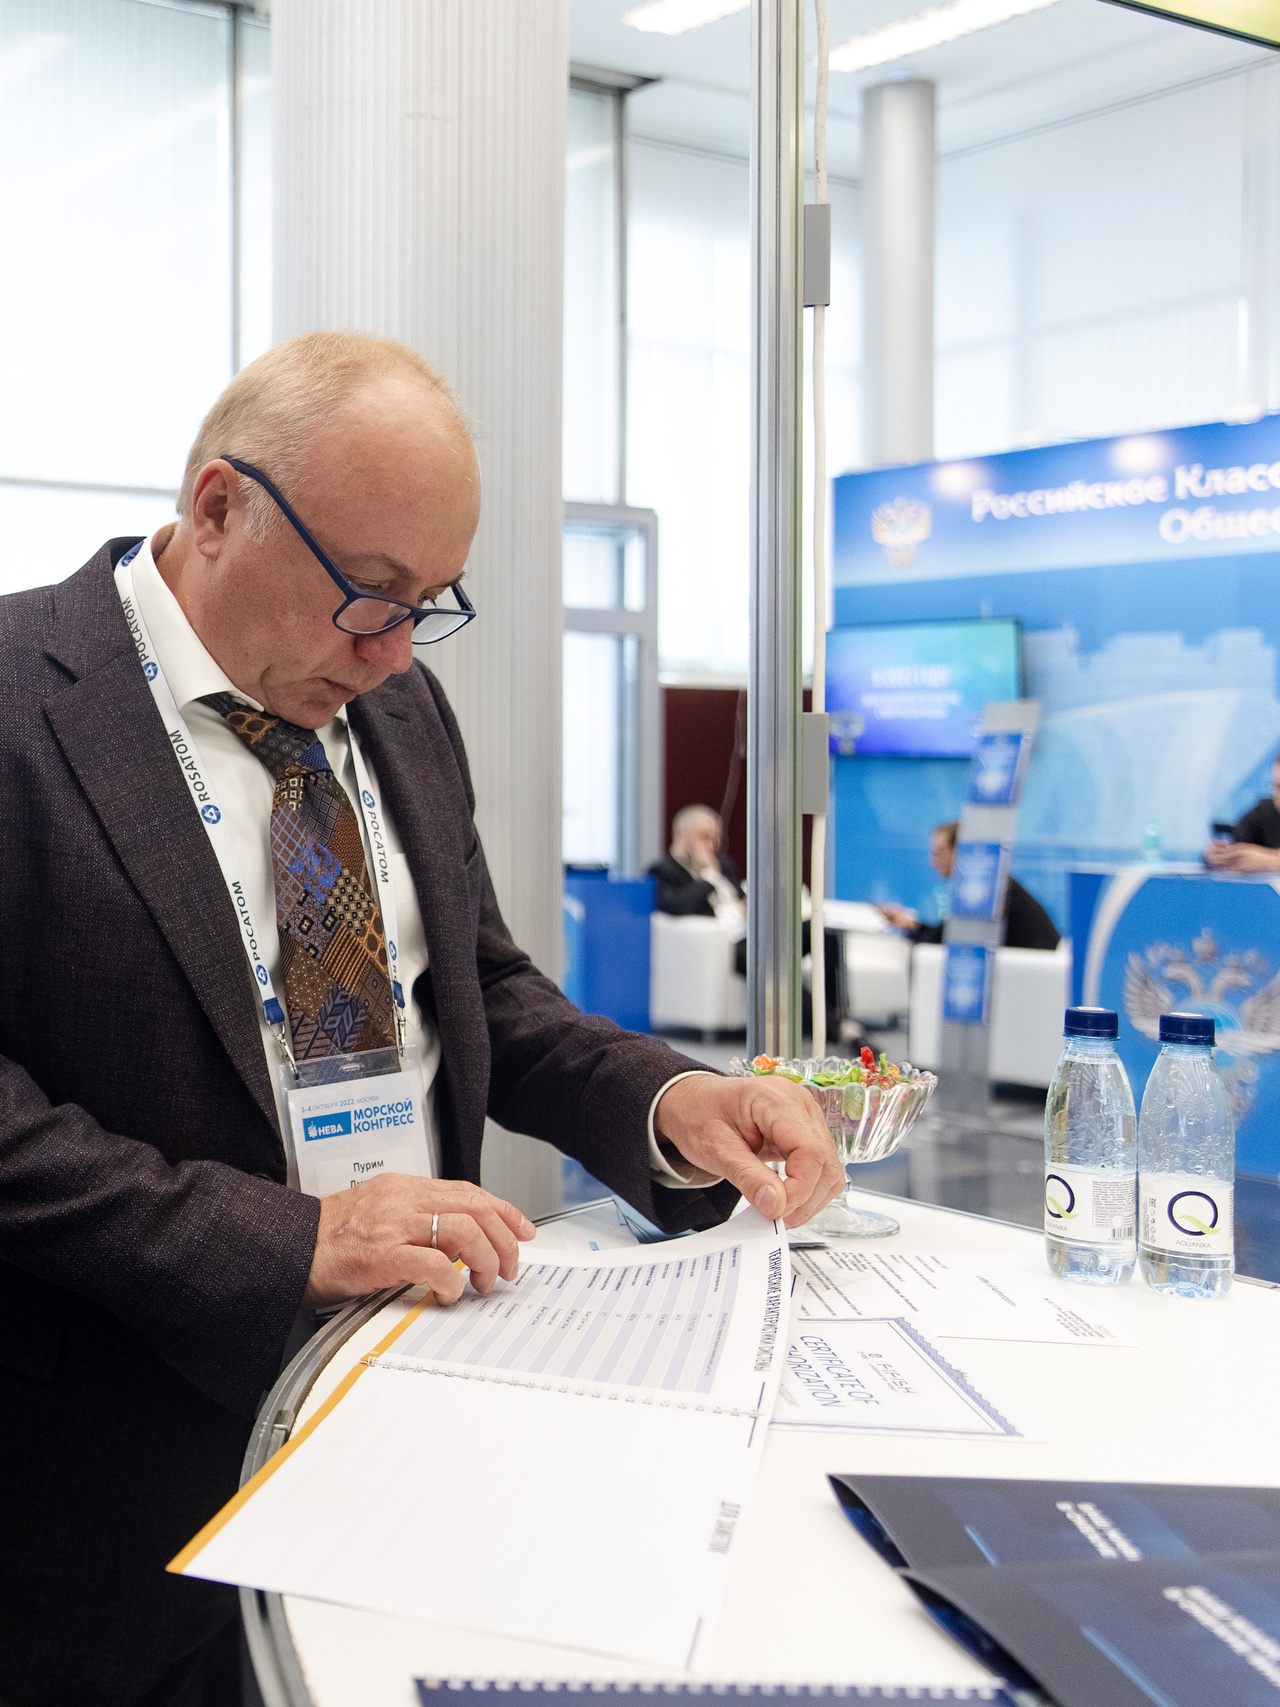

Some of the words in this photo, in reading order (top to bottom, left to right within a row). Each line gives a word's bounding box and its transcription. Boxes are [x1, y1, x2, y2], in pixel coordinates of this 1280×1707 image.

[971, 476, 1169, 523] Российское
[122, 596, 149, 662] РОСАТОМ
[169, 729, 210, 802] ROSATOM
[368, 810, 389, 884] РОСАТОМ
[232, 881, 260, 961] РОСАТОМ
[312, 1102, 338, 1112] ОКТЯБРЯ
[356, 1095, 379, 1104] МОСКВА
[354, 1098, 413, 1120] МОРСКОЙ
[354, 1113, 414, 1133] КОНГРЕСС
[318, 1123, 344, 1136] НЕВА
[353, 1160, 384, 1173] Пурим
[767, 1247, 781, 1295] ТЕХНИЧЕСКИЕ
[760, 1293, 781, 1345] ХАРАКТЕРИСТИКИ
[800, 1335, 866, 1389] CERTIFICATE
[848, 1391, 880, 1405] OF
[877, 1363, 917, 1393] FIFISH
